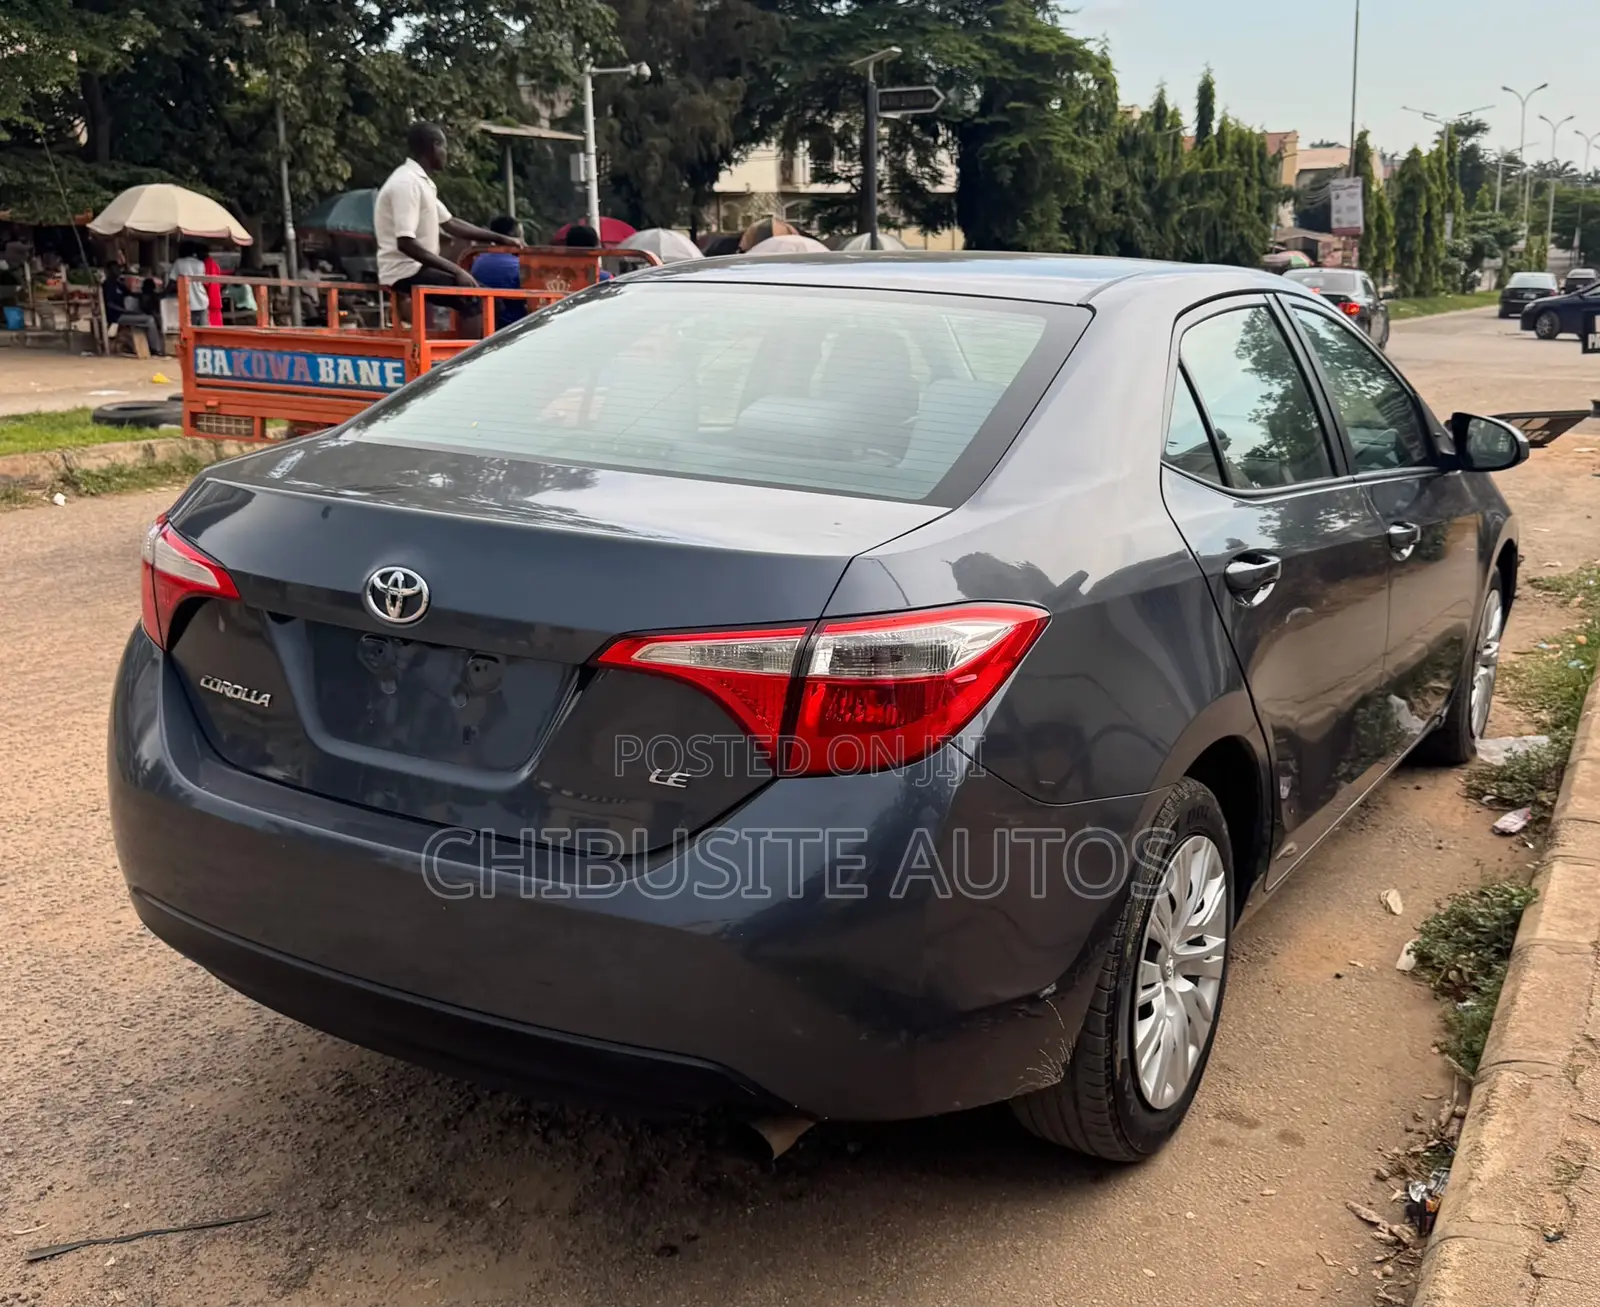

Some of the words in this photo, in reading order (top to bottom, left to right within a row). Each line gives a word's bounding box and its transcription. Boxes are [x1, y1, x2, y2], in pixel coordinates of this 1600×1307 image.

[317, 357, 404, 387] BANE
[200, 674, 272, 708] COROLLA
[648, 768, 692, 788] LE
